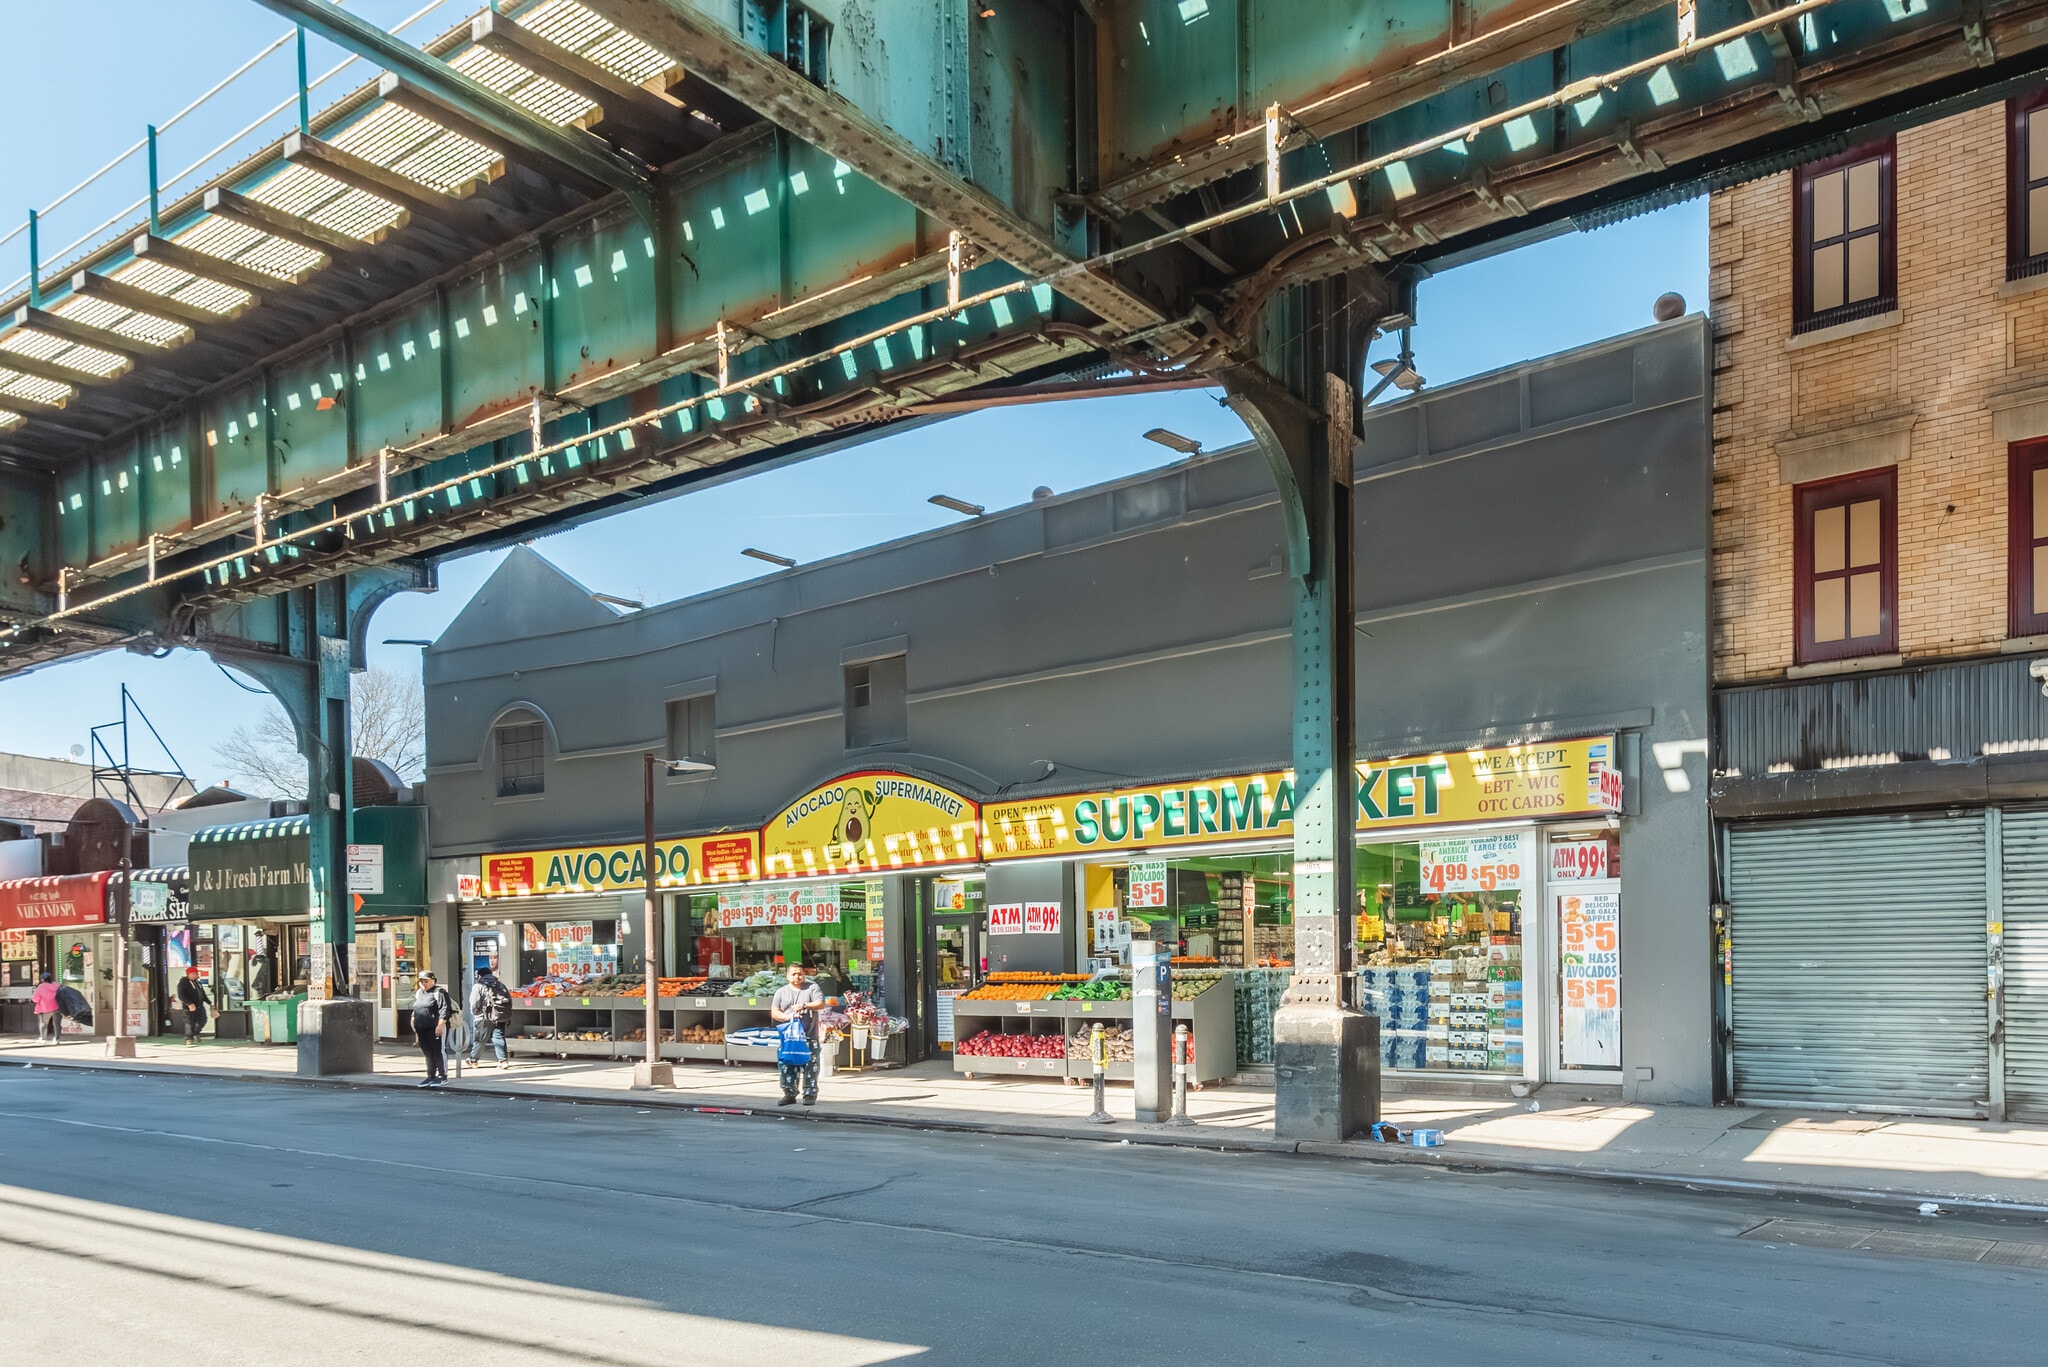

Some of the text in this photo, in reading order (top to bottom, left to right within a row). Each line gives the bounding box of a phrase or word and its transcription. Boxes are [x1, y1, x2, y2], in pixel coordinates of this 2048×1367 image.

[1477, 750, 1567, 770] WE ACCEPT
[1484, 780, 1513, 794] EBT
[1528, 774, 1560, 790] WIC
[1601, 770, 1610, 794] ATM
[786, 780, 964, 828] AVOCADO SUPERMARKET
[1074, 763, 1447, 845] SUPERMAKET
[1478, 793, 1565, 812] OTC CARDS
[993, 804, 1055, 820] OPEN 7 DAYS
[995, 838, 1055, 853] WHOLESALE
[1438, 846, 1469, 855] AMERICAN
[1474, 842, 1517, 852] LARGE EGGS
[546, 844, 690, 887] AVOCADO
[1443, 855, 1468, 863] CHEESE
[1553, 846, 1605, 878] ATM 99¢
[350, 864, 357, 872] 2
[1132, 870, 1164, 882] AVOCADOS
[1557, 870, 1576, 878] ONLY
[194, 871, 200, 892] J
[204, 870, 213, 891] &
[216, 869, 222, 890] J
[225, 866, 256, 889] Fresh
[260, 865, 290, 886] Farm
[460, 878, 473, 890] ATM
[1132, 884, 1144, 900] 5
[128, 900, 189, 920] ARBER SH
[990, 908, 1020, 926] ATM
[1026, 907, 1041, 922] ATM
[1588, 914, 1616, 922] APPLES
[1566, 924, 1583, 943] 5
[1588, 953, 1616, 963] HASS
[1160, 966, 1166, 981] P
[1566, 966, 1617, 978] AVOCADOS
[1568, 980, 1584, 1000] 5
